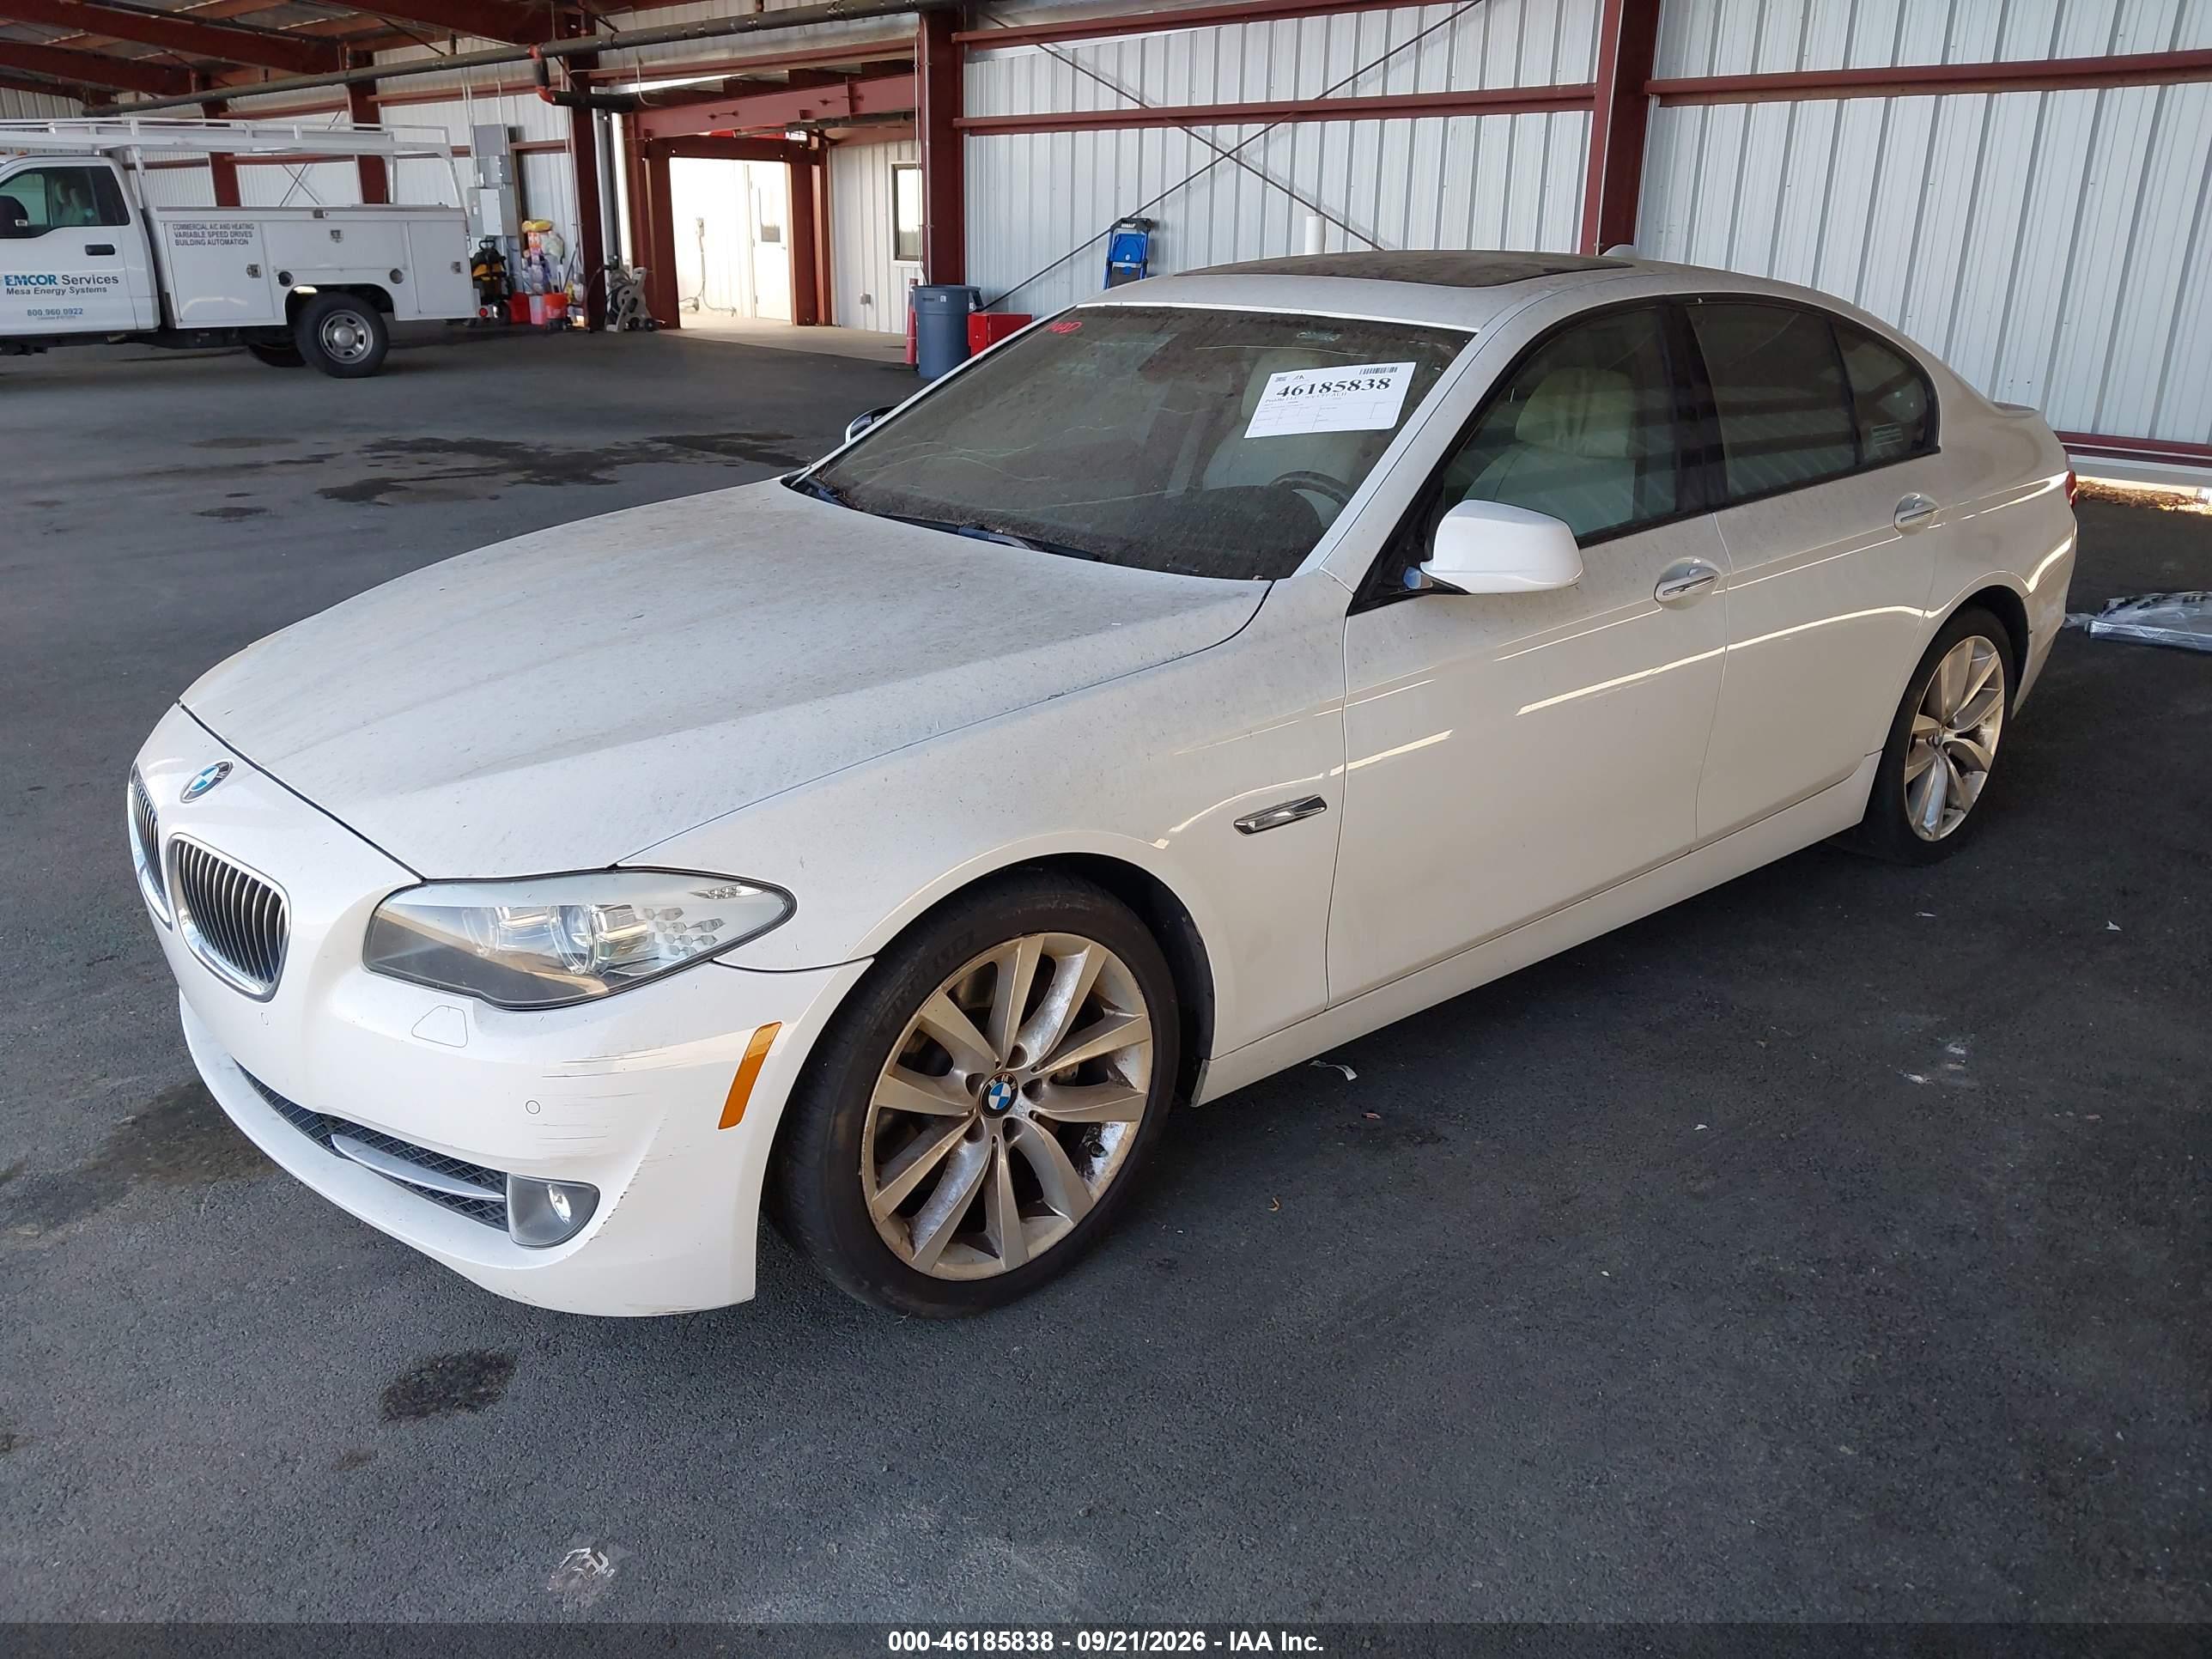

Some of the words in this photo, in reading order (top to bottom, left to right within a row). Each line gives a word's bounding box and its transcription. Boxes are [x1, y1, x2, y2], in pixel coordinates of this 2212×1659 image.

[4, 275, 58, 286] EMCOR
[61, 274, 119, 285] Services
[33, 287, 66, 296] Energy
[69, 286, 107, 295] Systems
[1276, 377, 1392, 398] 46185838
